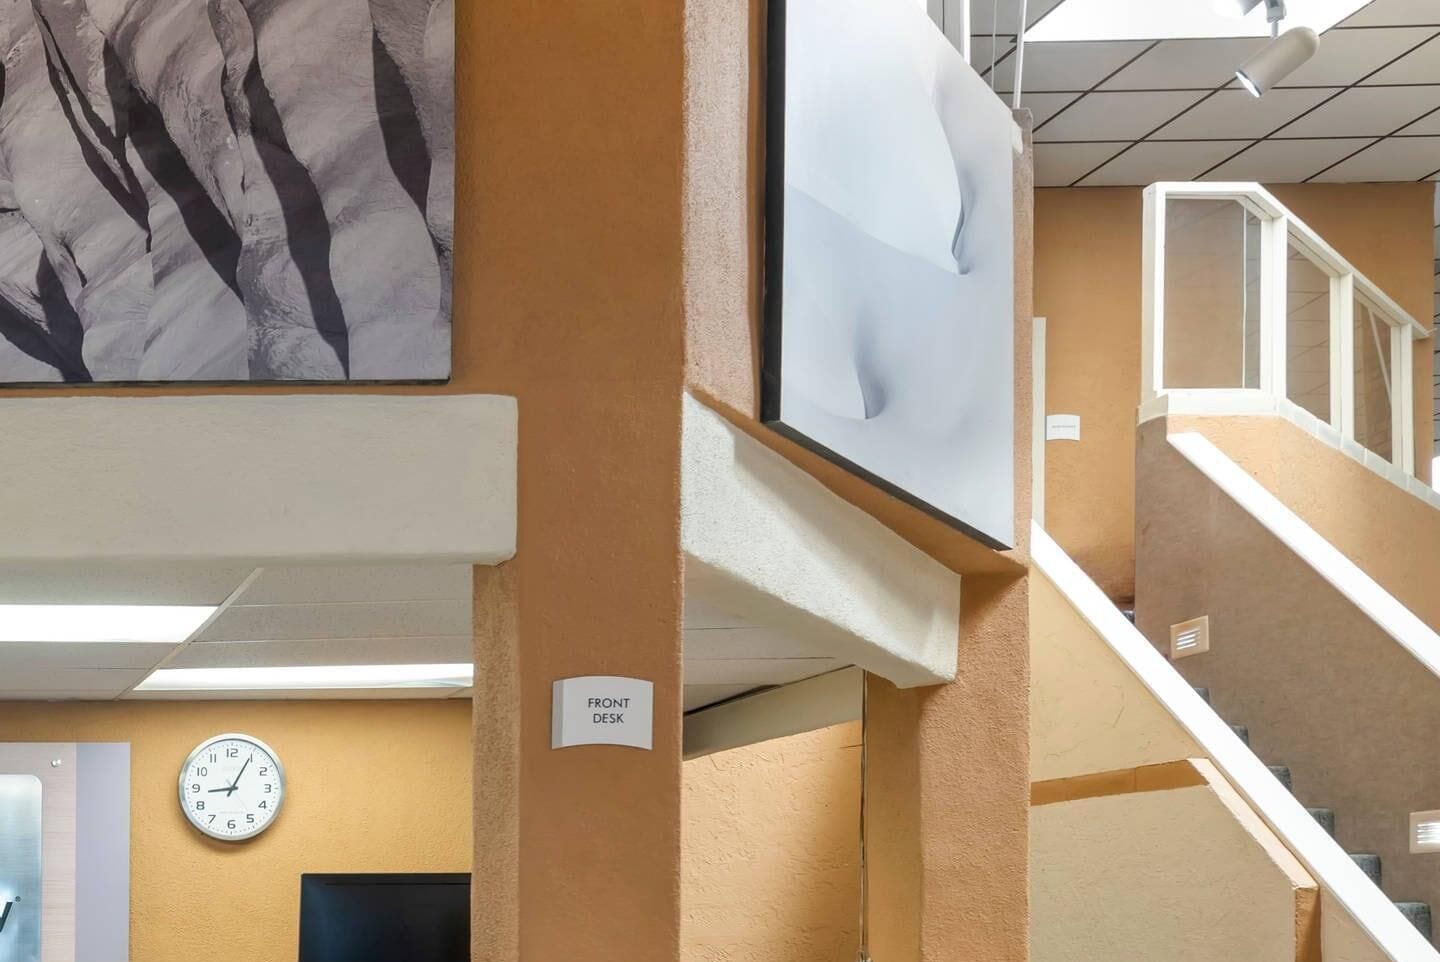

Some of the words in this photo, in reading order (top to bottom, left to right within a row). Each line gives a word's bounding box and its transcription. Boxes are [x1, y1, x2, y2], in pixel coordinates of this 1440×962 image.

[588, 698, 630, 708] FRONT
[593, 713, 624, 723] DESK
[209, 753, 217, 763] 11
[226, 748, 239, 758] 12
[196, 766, 208, 777] 10
[259, 766, 268, 777] 2
[191, 783, 201, 793] 9
[264, 783, 272, 794] 3
[196, 800, 206, 811] 8
[257, 800, 267, 810] 4
[208, 814, 217, 825] 7
[246, 813, 255, 824] 5
[227, 819, 237, 830] 6
